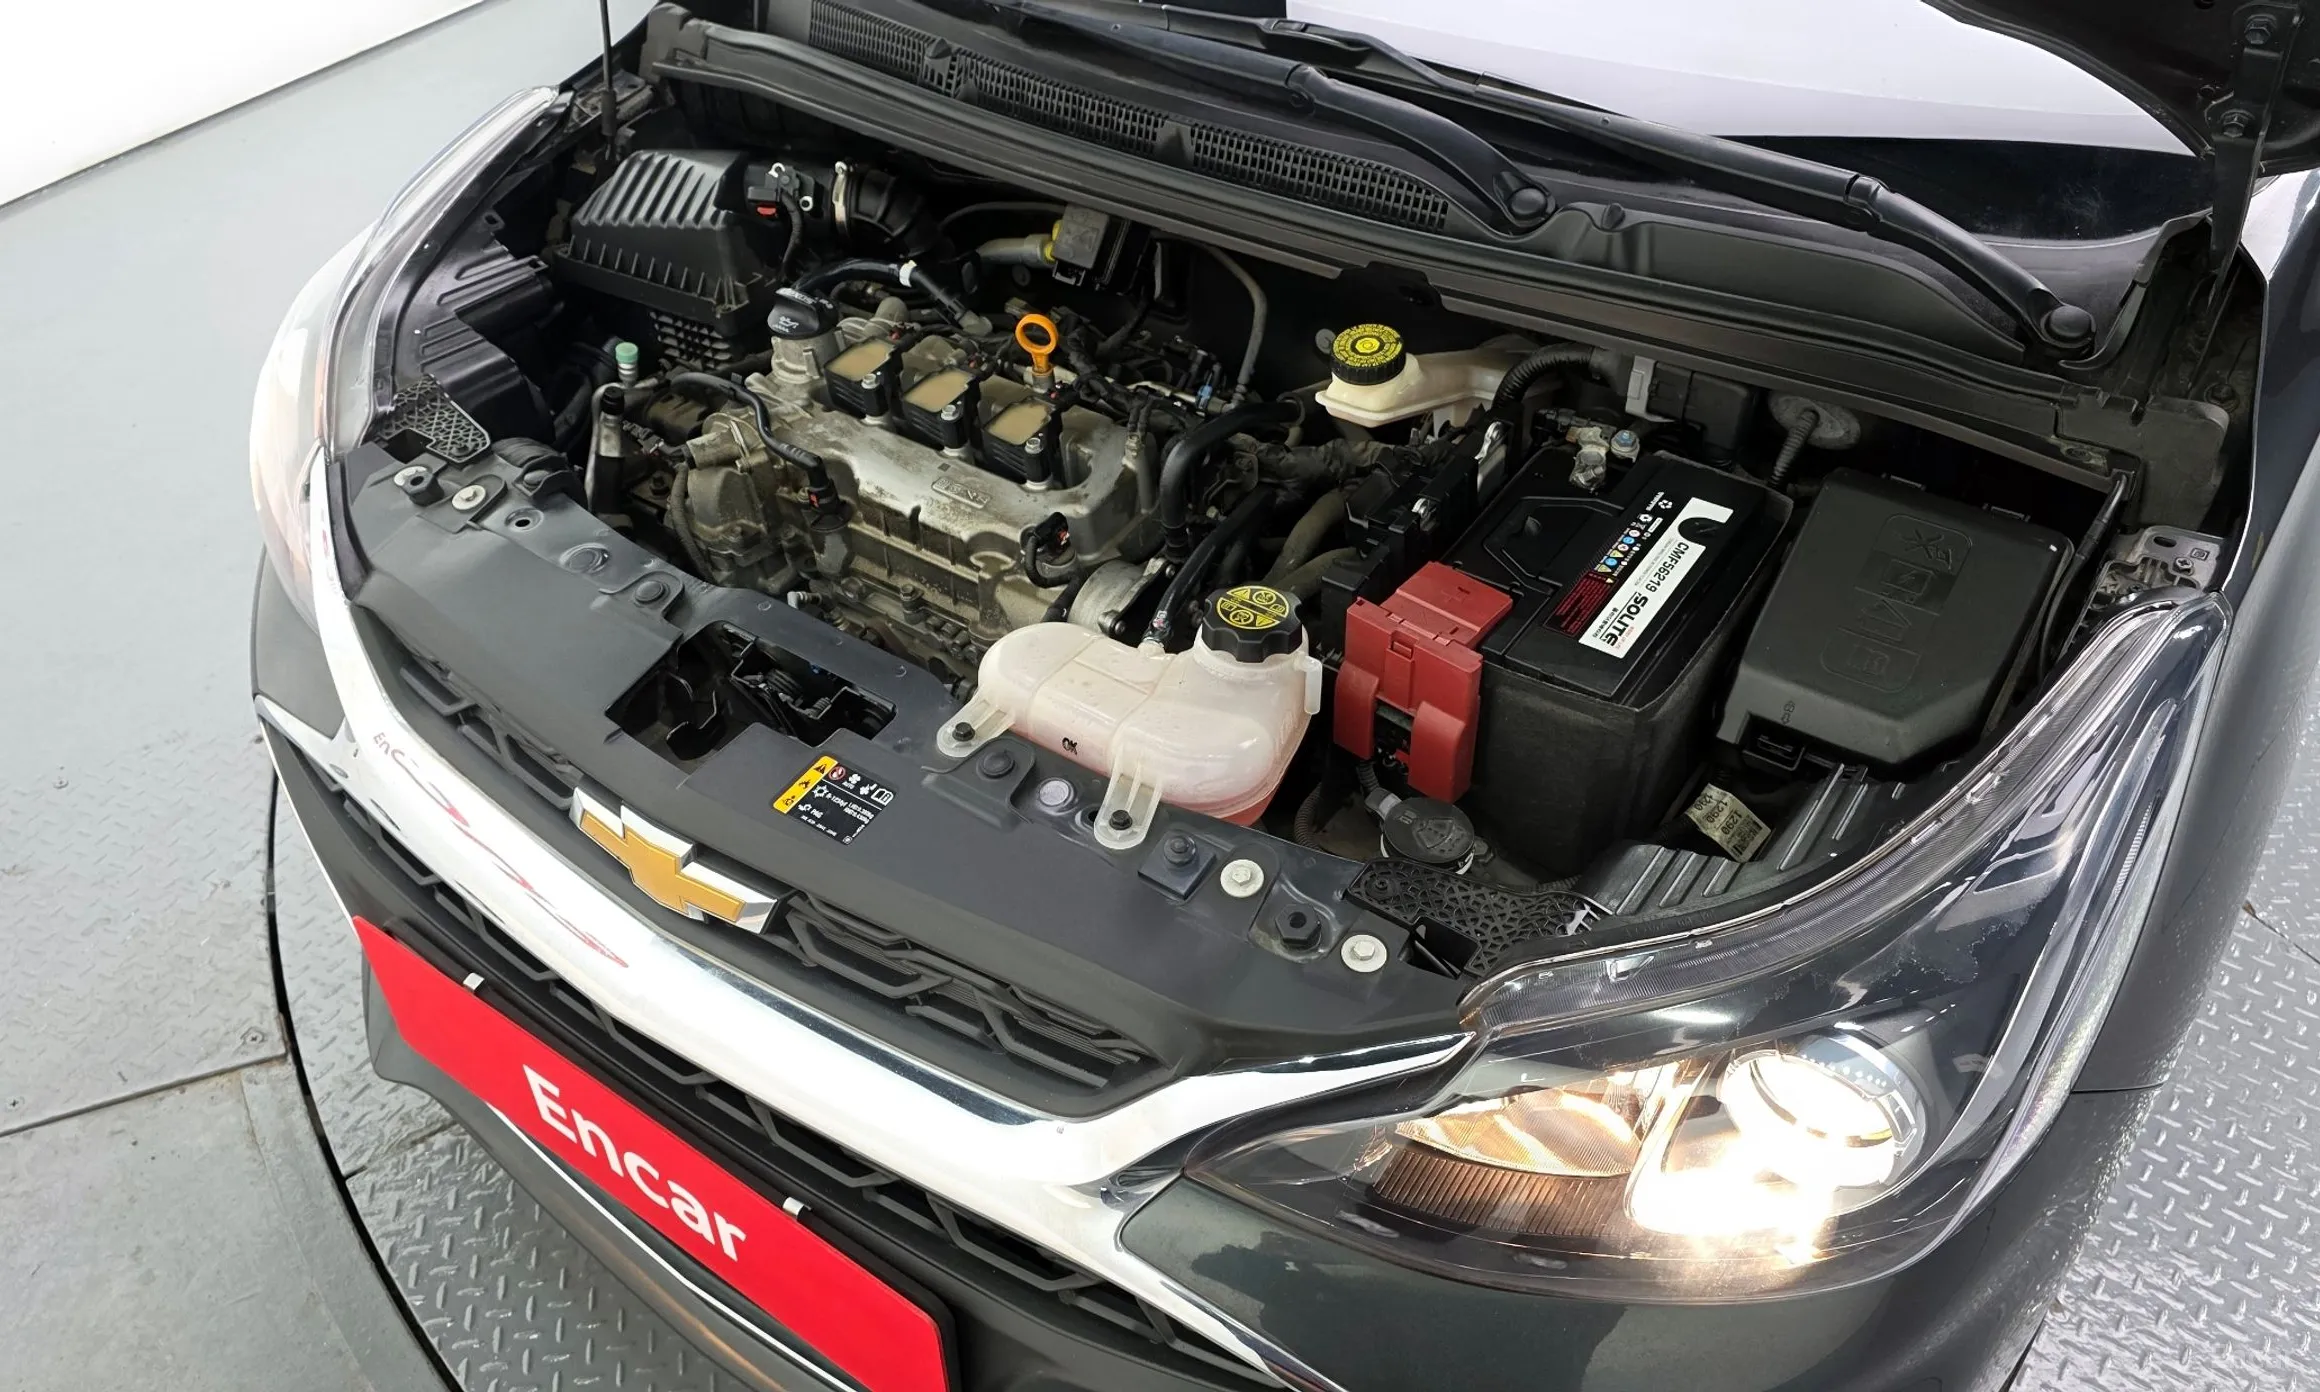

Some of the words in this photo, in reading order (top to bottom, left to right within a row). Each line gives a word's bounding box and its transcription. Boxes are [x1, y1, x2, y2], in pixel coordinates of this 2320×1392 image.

[1645, 542, 1690, 593] CMF56219
[1602, 593, 1649, 647] SOLITE
[1061, 737, 1078, 755] OK
[1706, 799, 1728, 823] 1290
[1721, 809, 1742, 835] 1290
[522, 1064, 747, 1262] Encar
